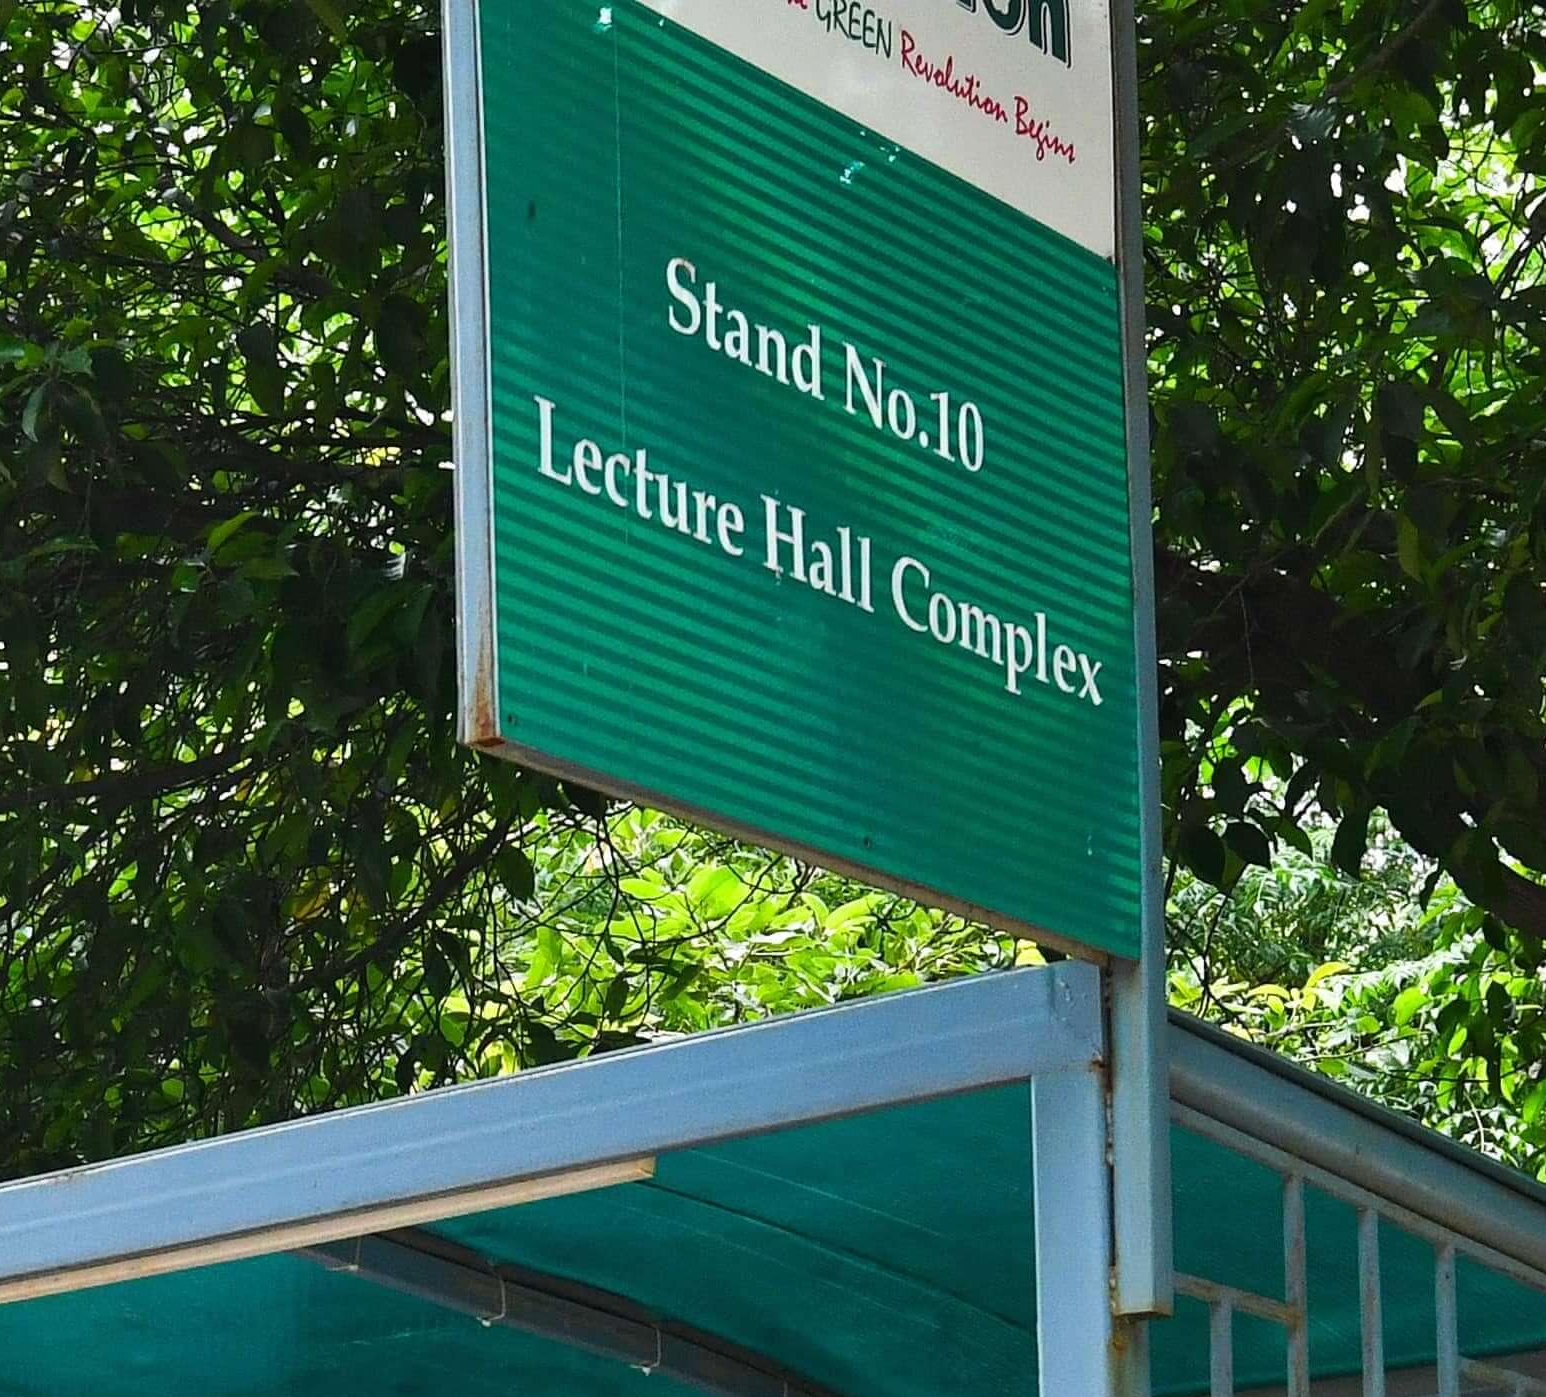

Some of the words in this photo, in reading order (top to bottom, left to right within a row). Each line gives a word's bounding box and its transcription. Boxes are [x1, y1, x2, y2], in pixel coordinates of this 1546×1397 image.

[813, 0, 893, 59] GREEN
[899, 30, 1009, 123] Revolution
[665, 256, 825, 401] Stand
[842, 340, 985, 472] No.10
[533, 393, 746, 556] Lecture
[759, 492, 876, 614] Hall
[890, 555, 1105, 707] Complex
